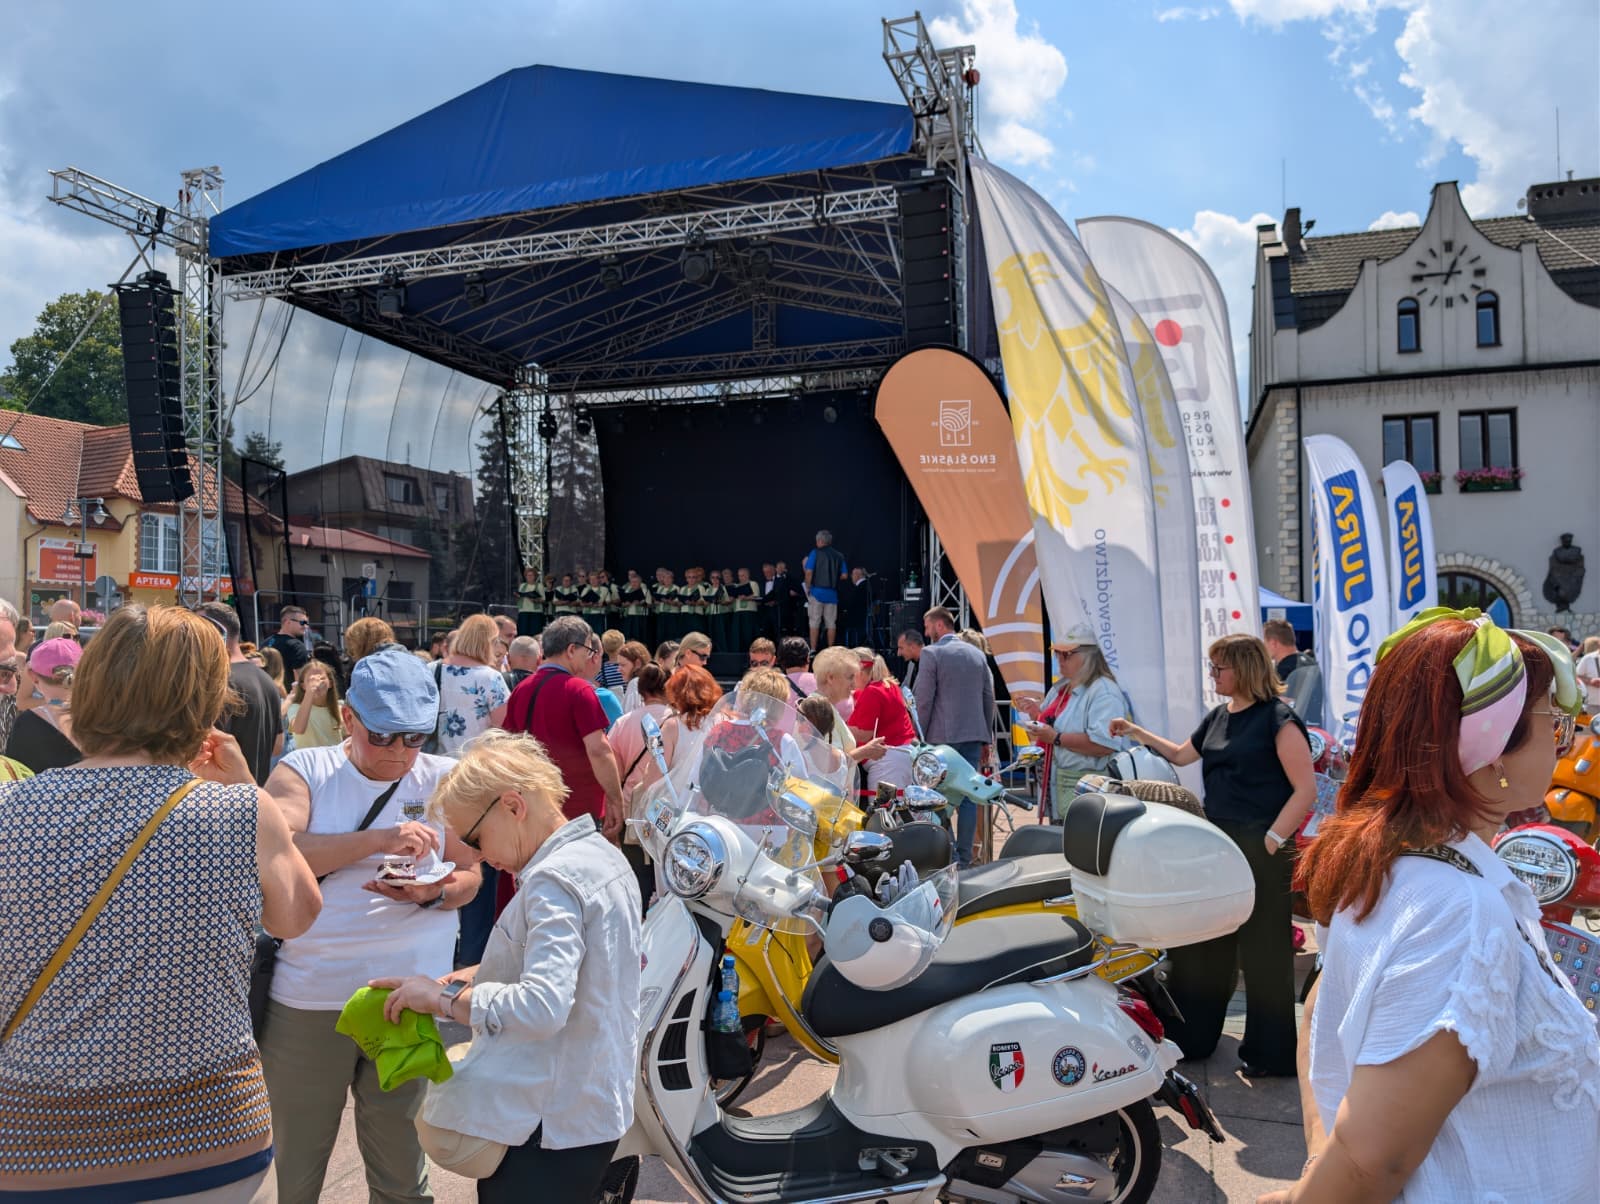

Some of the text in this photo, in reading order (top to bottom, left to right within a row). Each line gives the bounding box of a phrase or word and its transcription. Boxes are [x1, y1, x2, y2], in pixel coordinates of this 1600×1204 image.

[136, 576, 172, 586] APTEKA
[991, 1062, 1024, 1082] Vespa
[1092, 1062, 1139, 1084] Vespa
